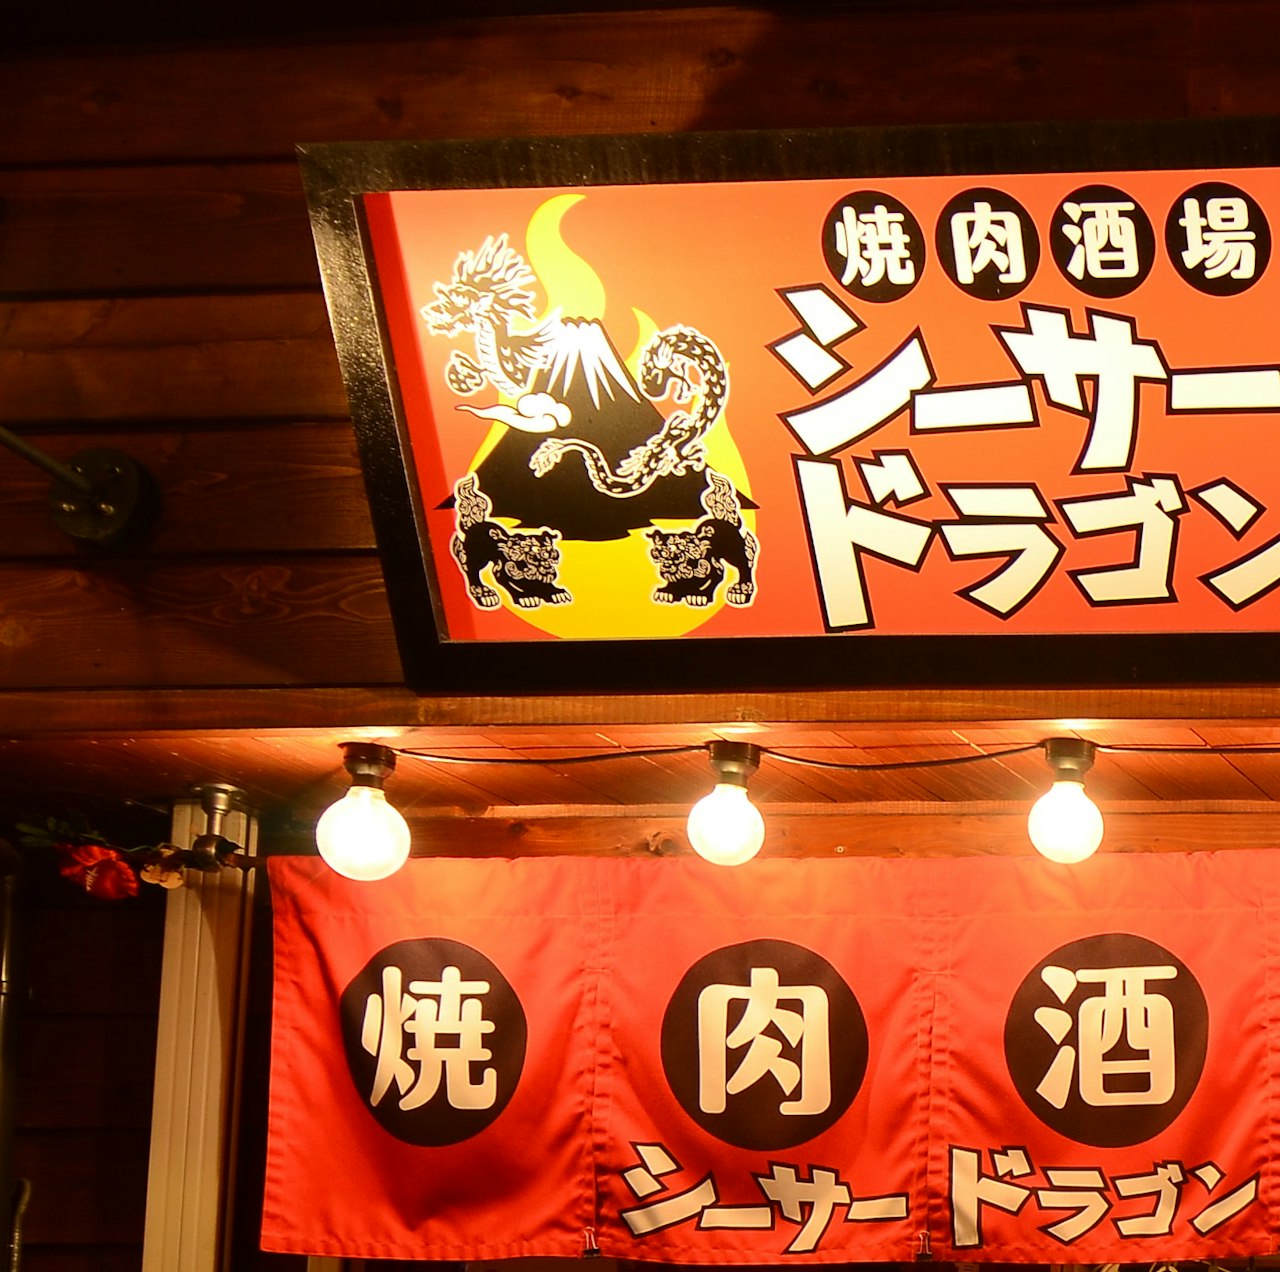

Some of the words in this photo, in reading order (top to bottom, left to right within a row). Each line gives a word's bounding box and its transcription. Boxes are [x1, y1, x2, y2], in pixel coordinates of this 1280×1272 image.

[834, 194, 1258, 288] 焼肉酒場
[620, 1142, 910, 1256] シーサー
[949, 1147, 1260, 1248] ドラゴン
